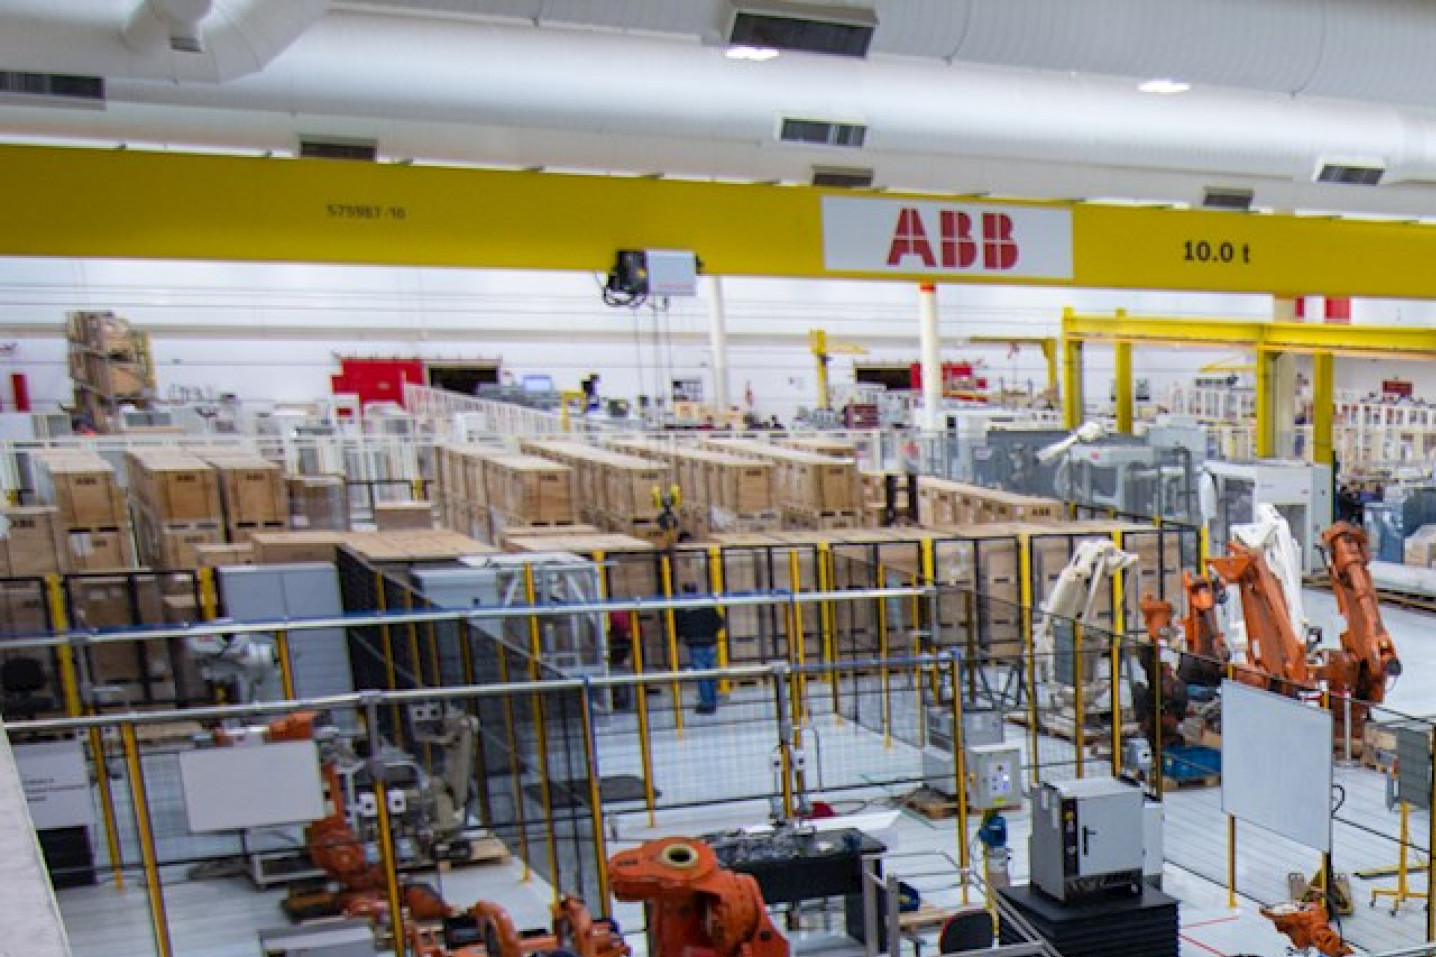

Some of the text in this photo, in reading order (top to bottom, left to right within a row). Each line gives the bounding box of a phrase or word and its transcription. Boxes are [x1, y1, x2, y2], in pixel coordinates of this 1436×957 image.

[887, 208, 1019, 270] ABB
[1184, 240, 1250, 265] 10.0 t
